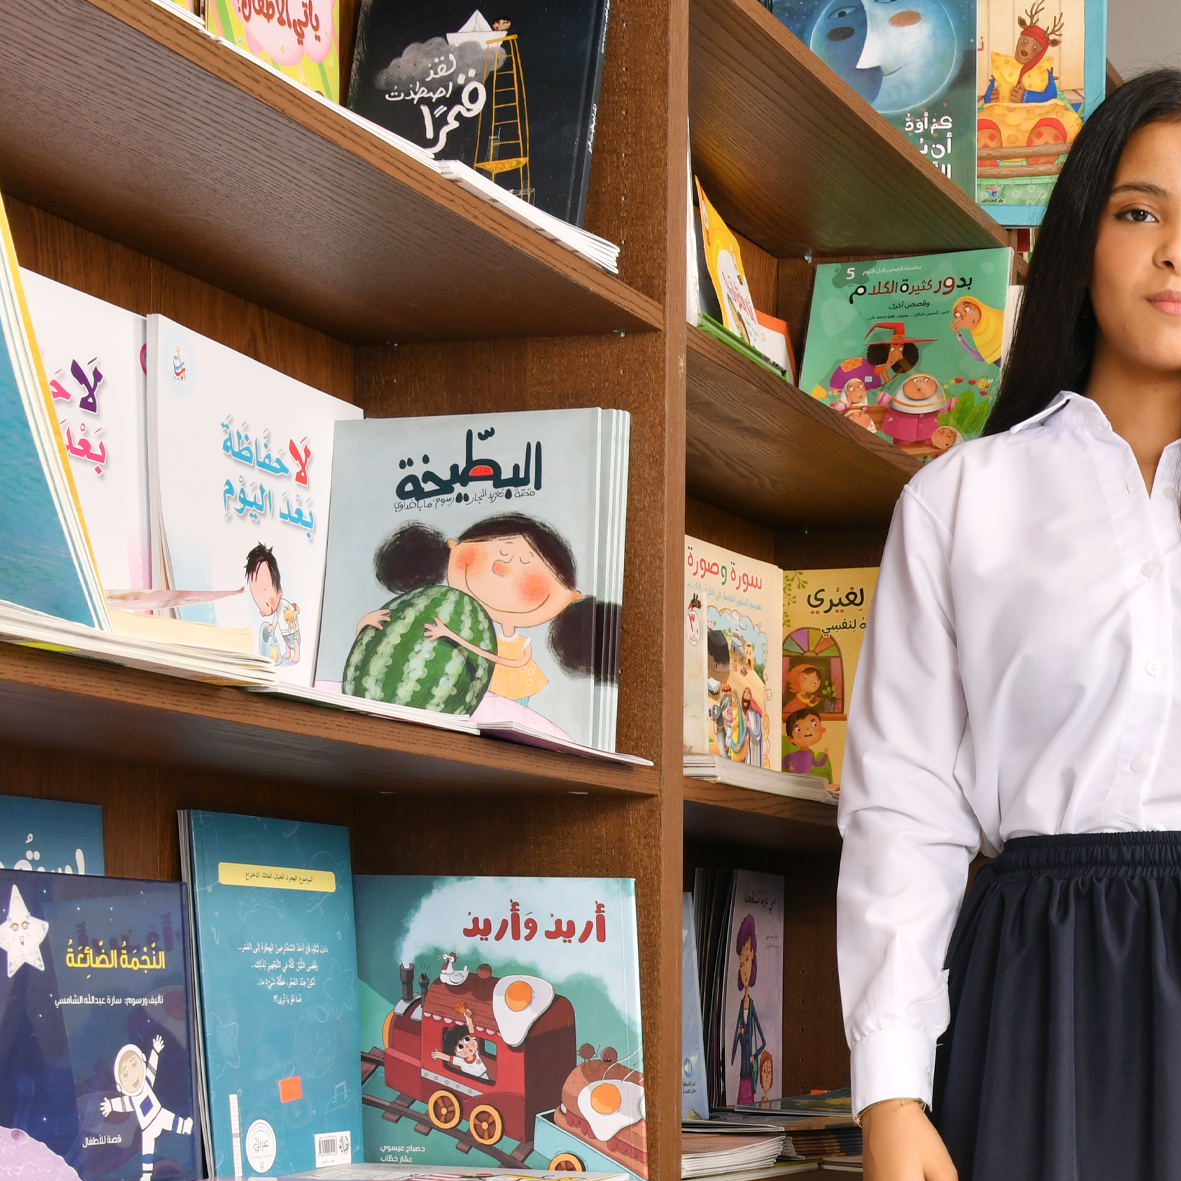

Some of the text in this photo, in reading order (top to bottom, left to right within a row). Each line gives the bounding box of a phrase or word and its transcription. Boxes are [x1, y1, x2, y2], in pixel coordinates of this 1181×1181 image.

[846, 267, 856, 280] 5
[849, 276, 973, 304] بدور كثيرة الكلام
